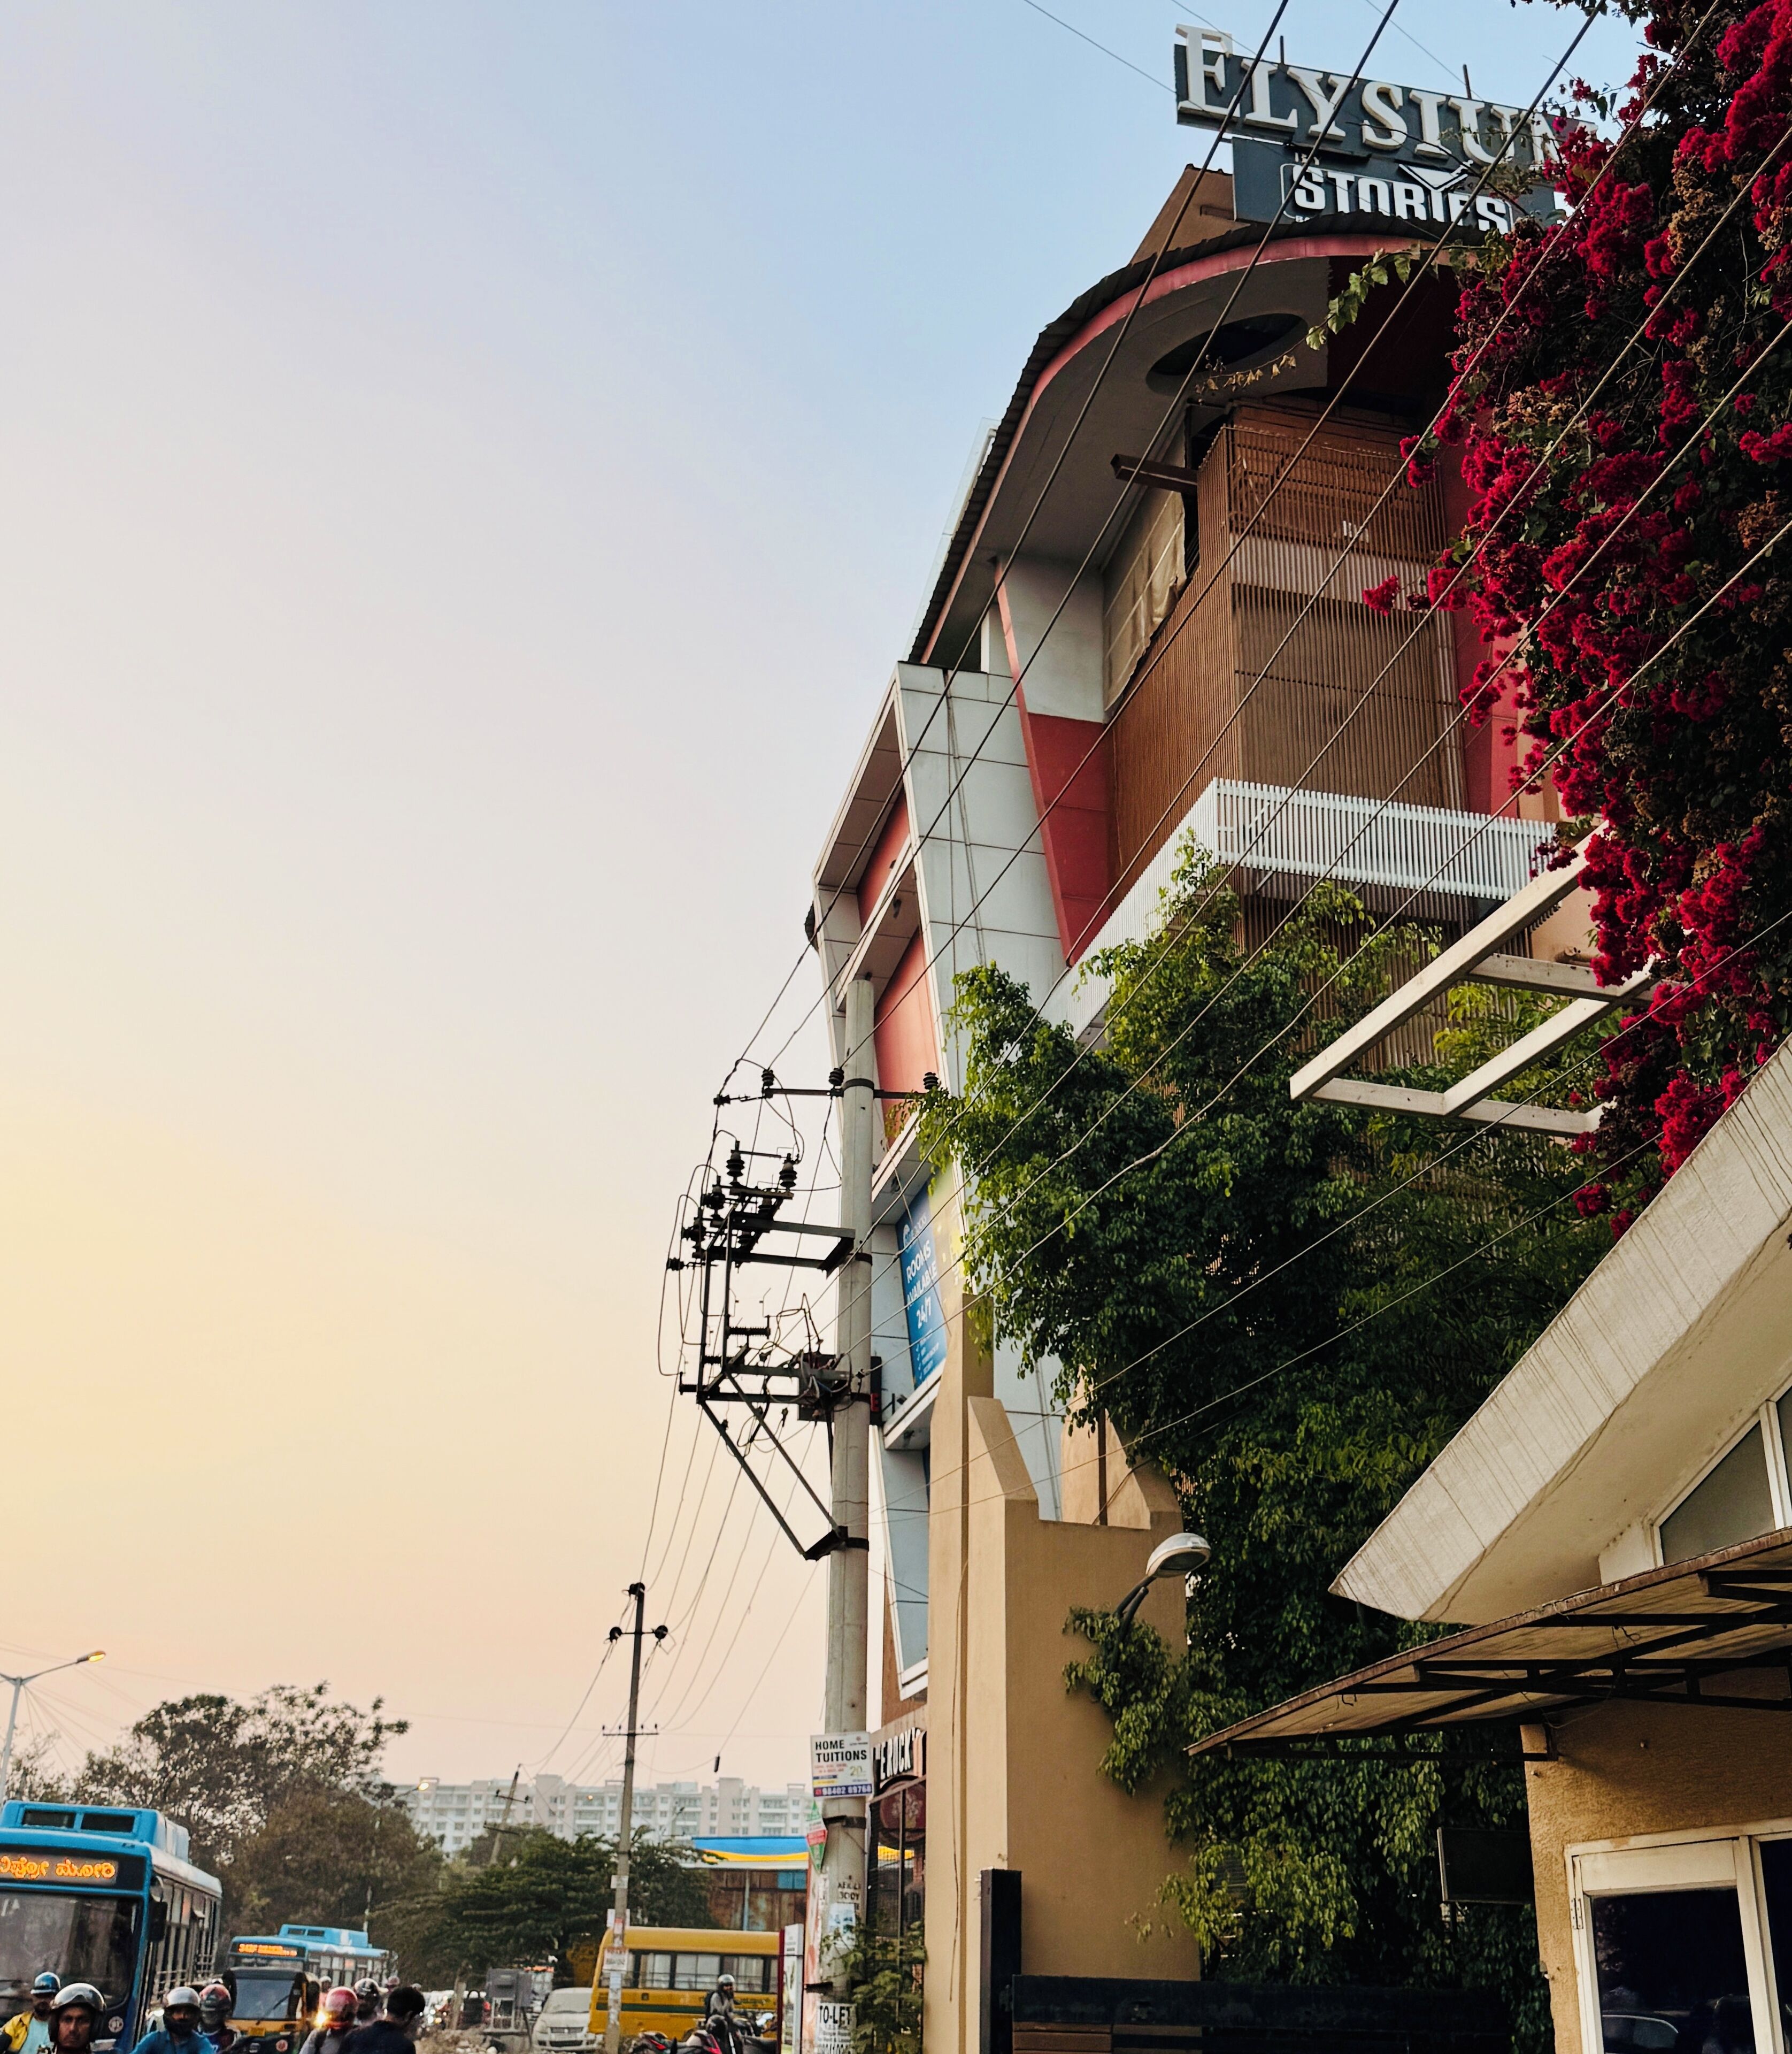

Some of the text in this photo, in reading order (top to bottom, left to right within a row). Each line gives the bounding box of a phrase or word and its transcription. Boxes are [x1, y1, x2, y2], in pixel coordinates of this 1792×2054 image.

[1293, 165, 1509, 234] STORIES
[906, 1240, 932, 1283] ROOMS
[907, 1261, 938, 1310] AVAILABLE
[916, 1296, 932, 1330] 24/7
[816, 1739, 845, 1751] HOME
[816, 1750, 867, 1763] TUITIONS
[820, 2005, 851, 2025] TO-LET
